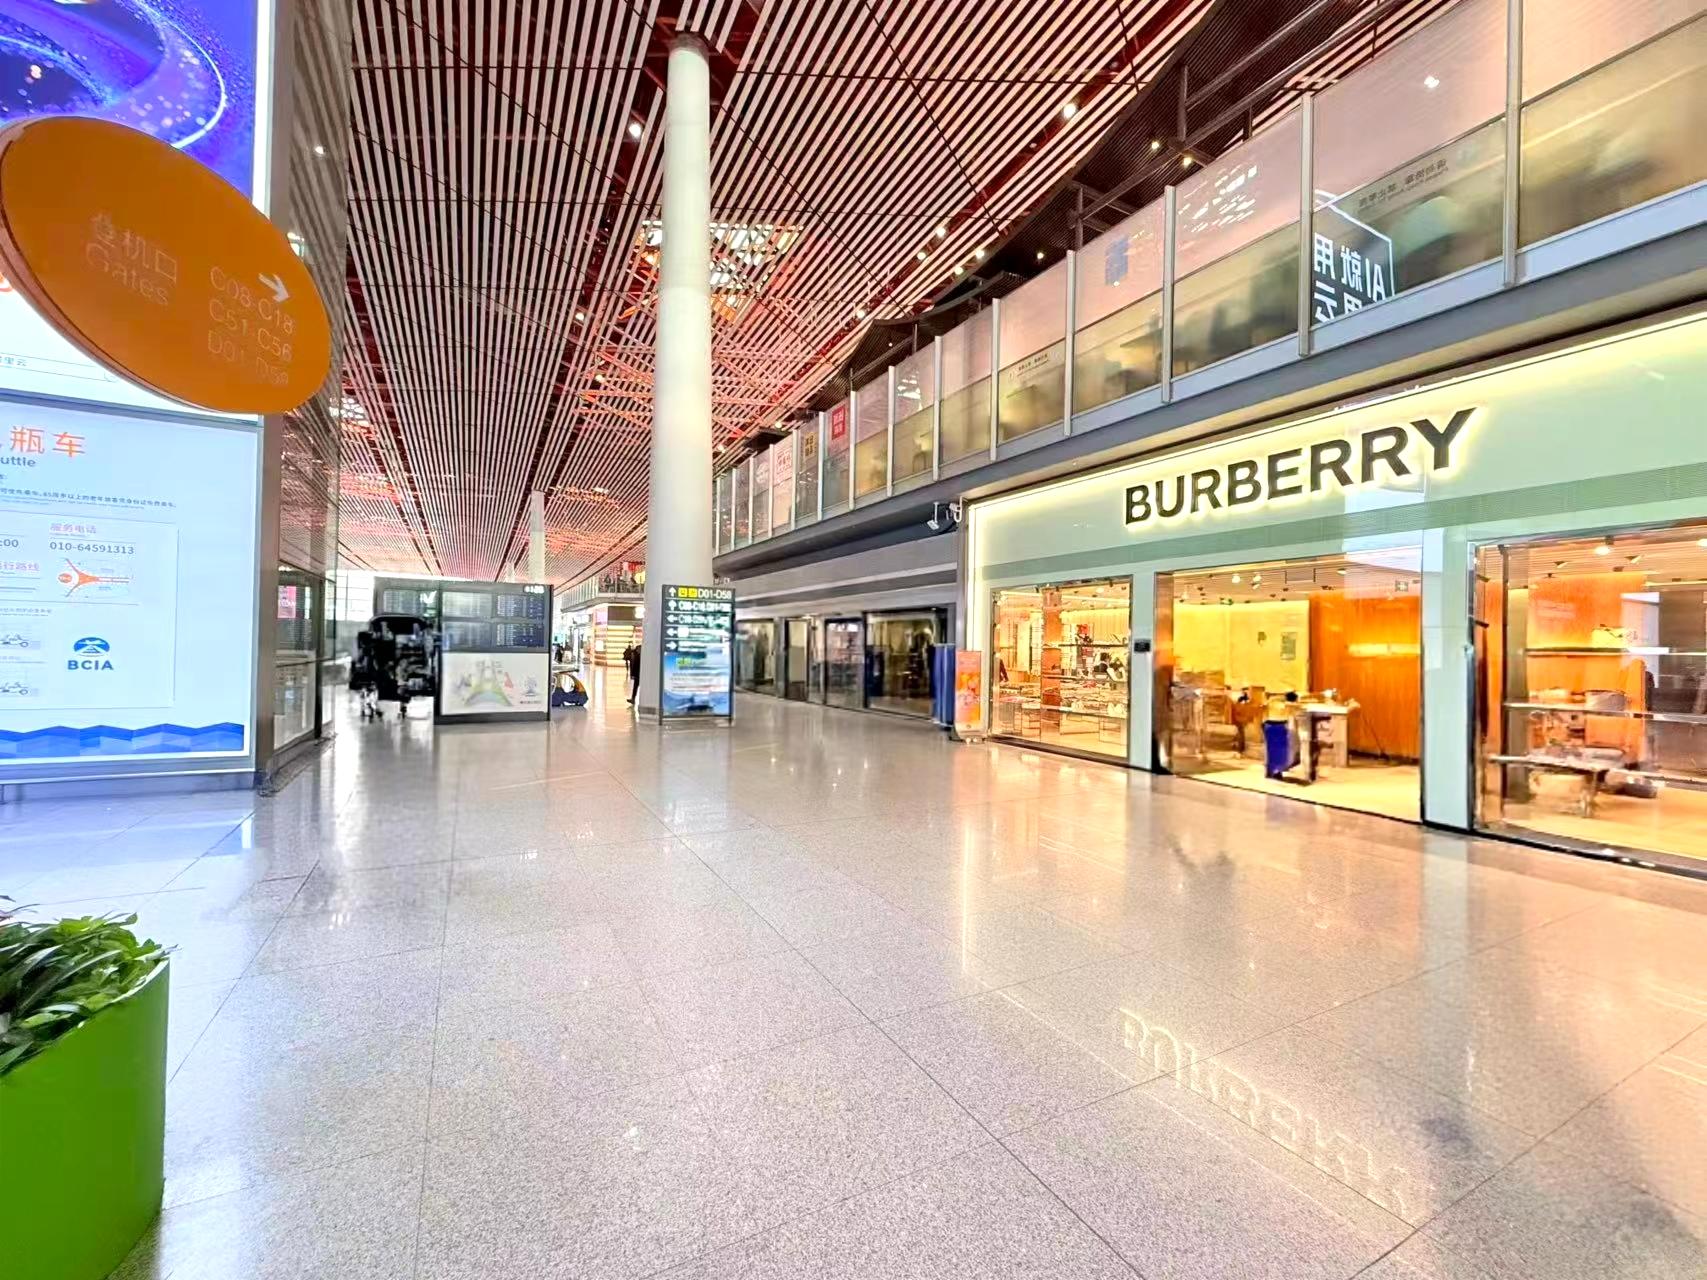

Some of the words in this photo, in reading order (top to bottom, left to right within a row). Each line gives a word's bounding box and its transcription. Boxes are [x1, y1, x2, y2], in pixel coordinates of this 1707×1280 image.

[85, 241, 169, 307] Gates
[1125, 407, 1478, 525] BURBERRY
[49, 541, 135, 555] 010-64591313
[67, 659, 114, 671] BCIA
